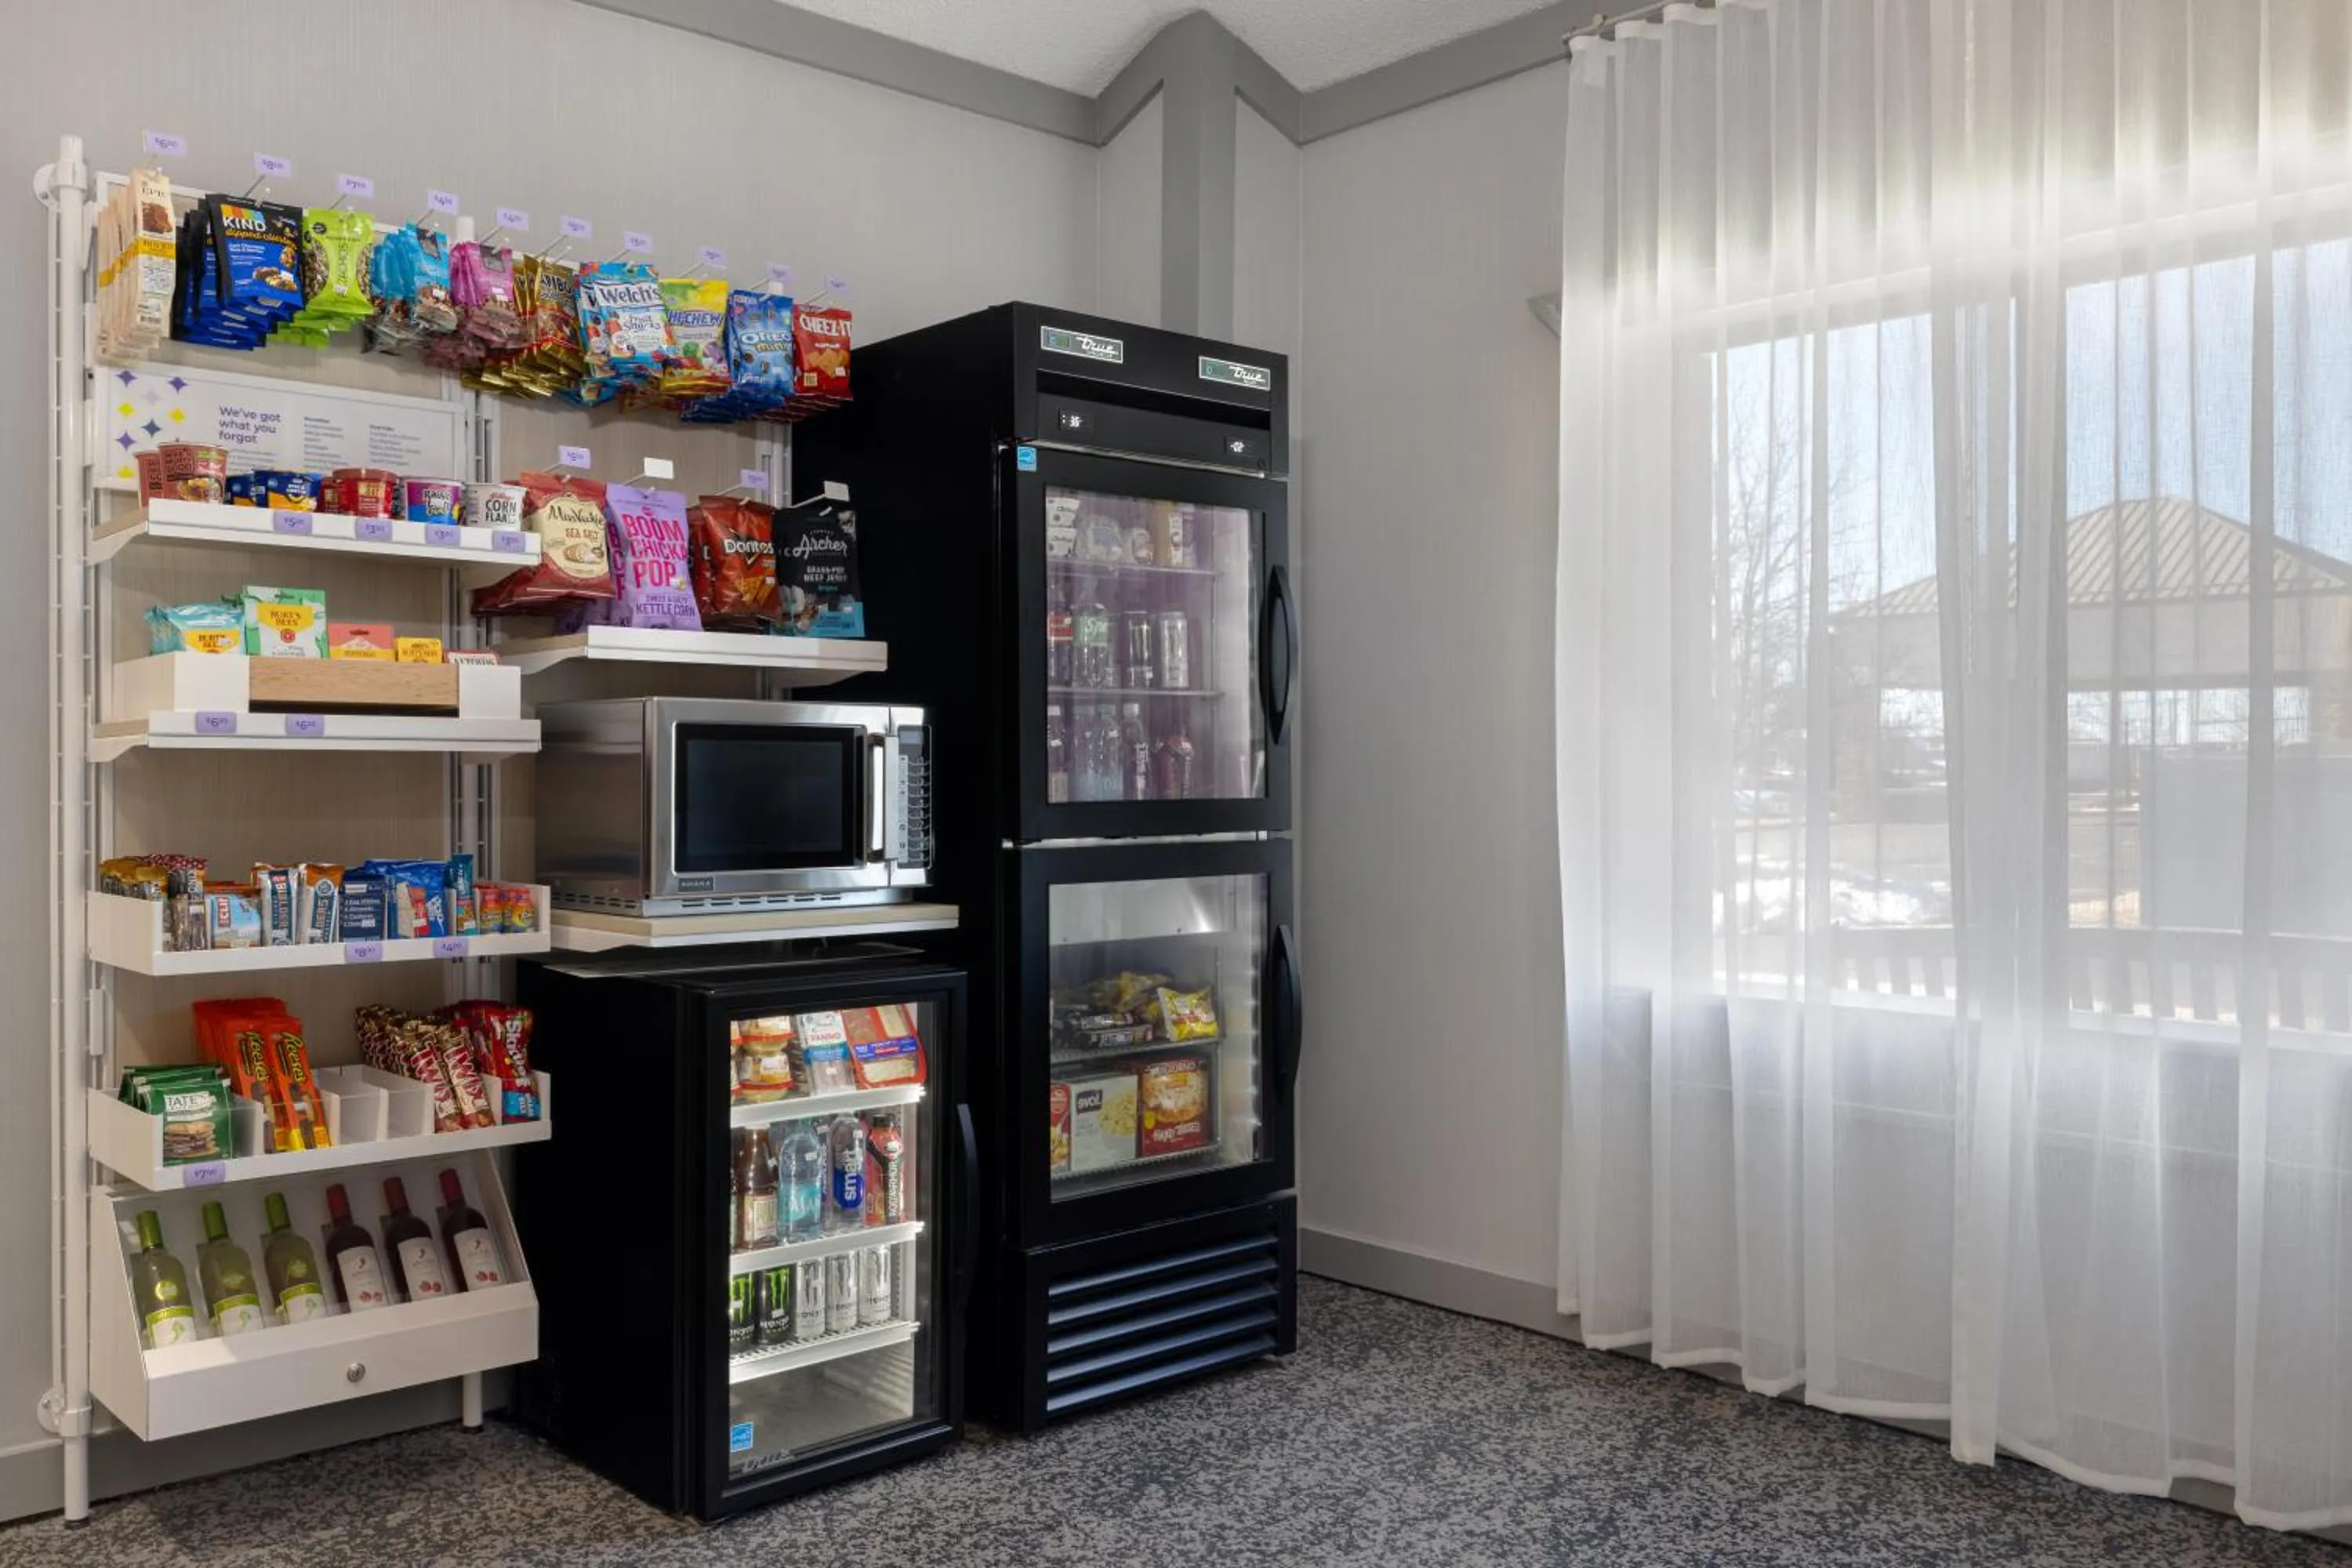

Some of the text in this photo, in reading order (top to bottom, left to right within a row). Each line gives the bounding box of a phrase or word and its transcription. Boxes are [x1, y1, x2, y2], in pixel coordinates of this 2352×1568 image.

[223, 216, 267, 232] KIND
[599, 285, 662, 303] Welch's
[219, 405, 281, 423] We've got
[219, 419, 277, 434] what you
[219, 430, 258, 445] forgot
[485, 499, 517, 514] CORN
[485, 511, 517, 525] FLAK
[564, 528, 581, 539] SEA
[622, 514, 686, 543] BOOM
[629, 539, 687, 561] CHICKA
[724, 539, 775, 555] Doritos
[792, 533, 848, 560] Archer
[633, 561, 677, 590] POP
[636, 602, 695, 619] KETTLE CORN
